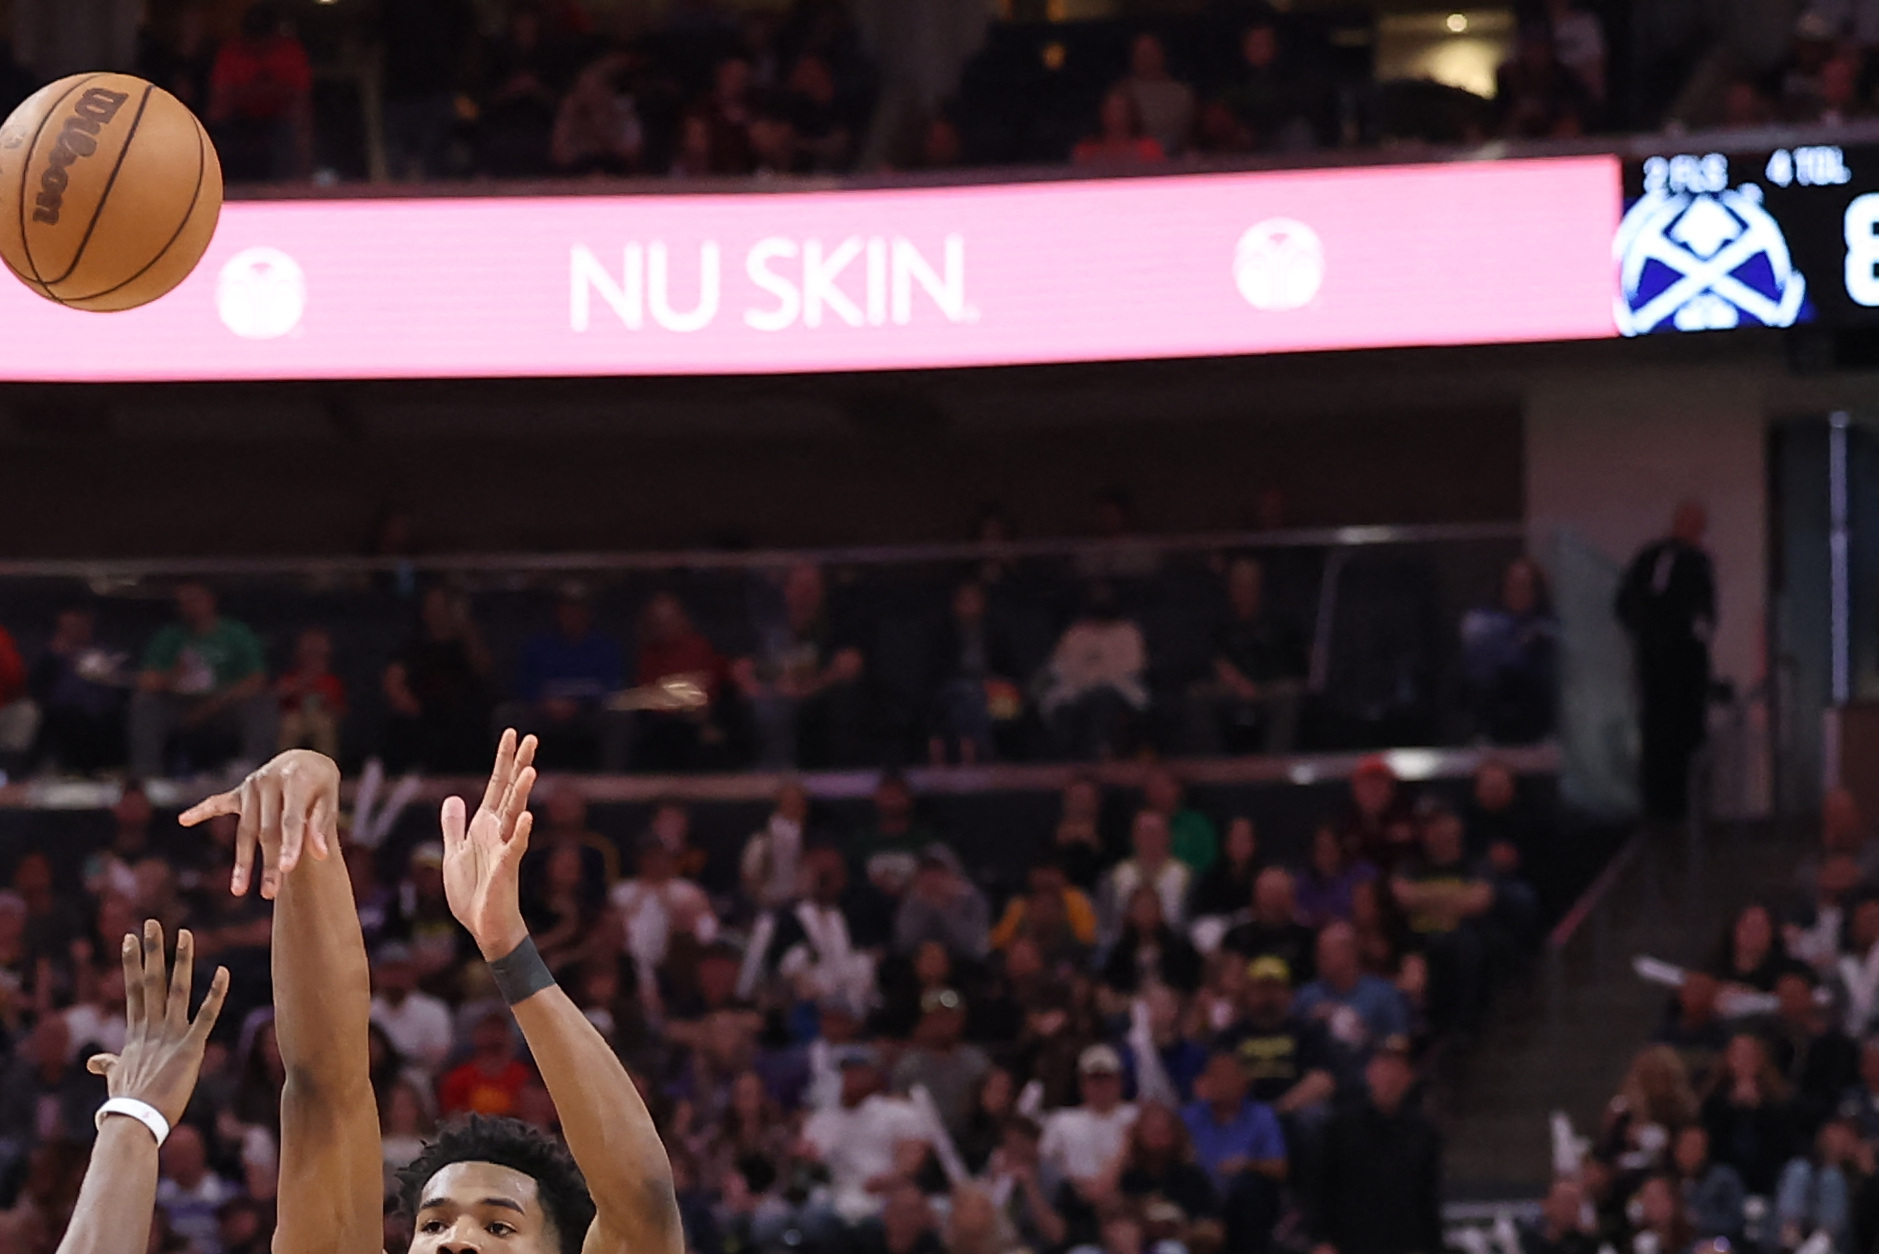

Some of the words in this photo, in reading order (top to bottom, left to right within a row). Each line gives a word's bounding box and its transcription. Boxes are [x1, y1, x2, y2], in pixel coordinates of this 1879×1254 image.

[32, 87, 130, 226] Wilson
[569, 238, 720, 332] NU
[743, 233, 966, 332] SKIN
